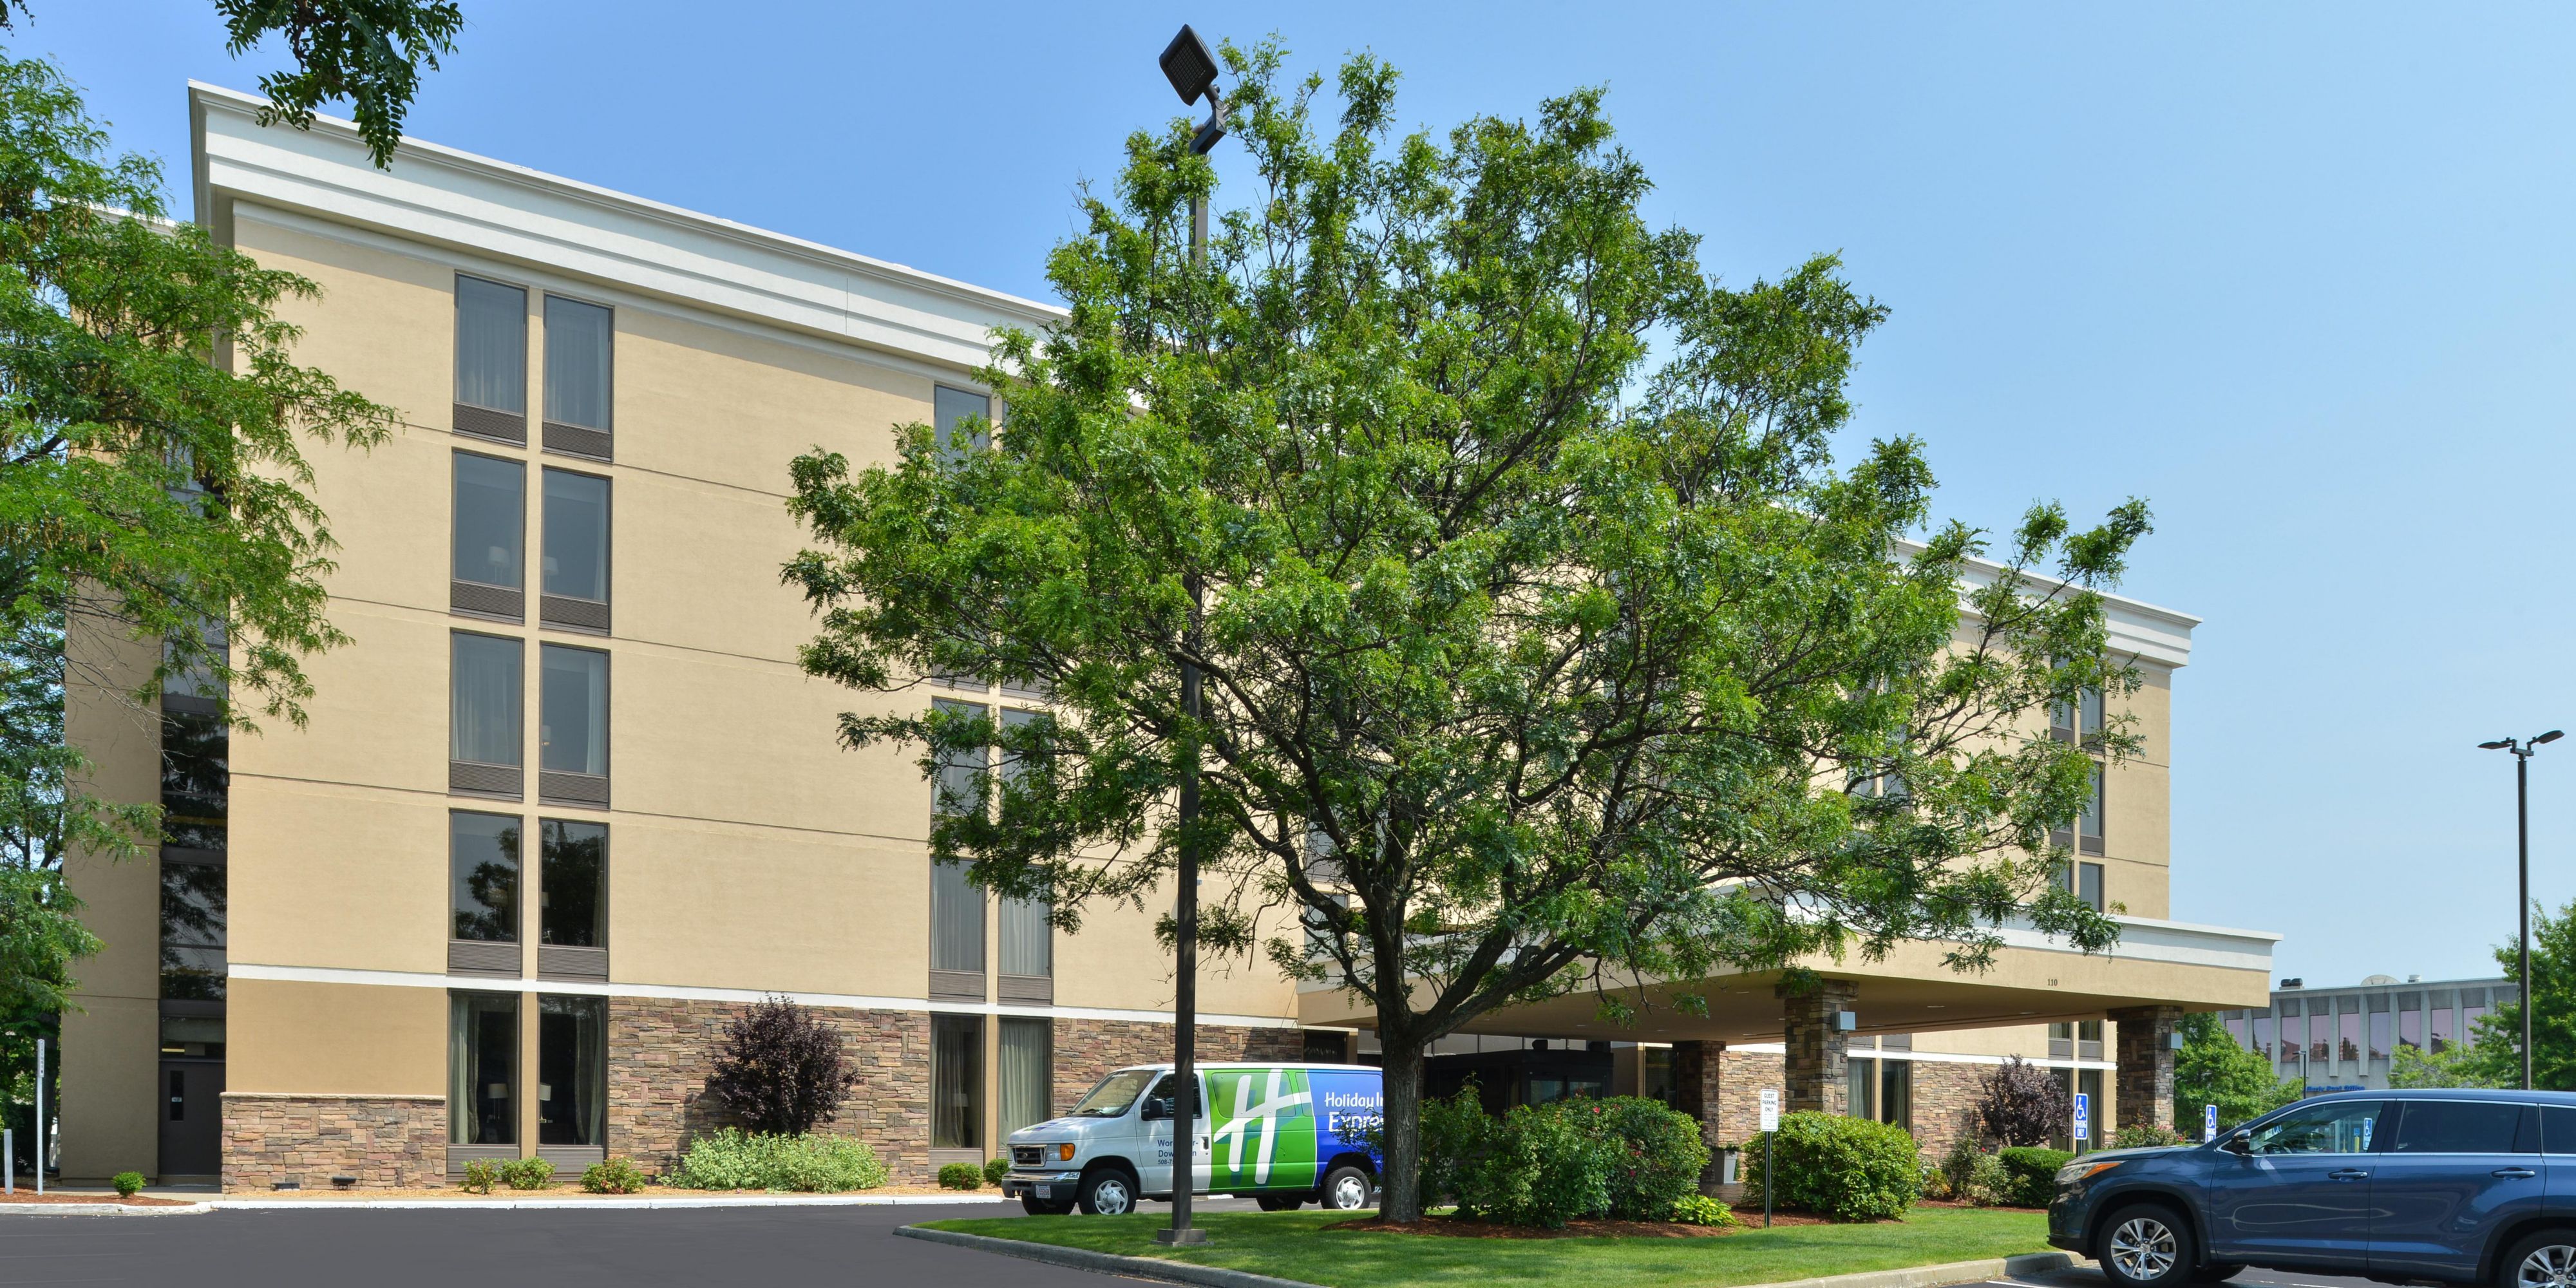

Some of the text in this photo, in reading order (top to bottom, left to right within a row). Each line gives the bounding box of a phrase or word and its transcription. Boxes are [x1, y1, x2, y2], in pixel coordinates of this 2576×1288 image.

[2047, 978, 2058, 987] 110
[1324, 1092, 1374, 1109] Holiday
[2077, 1128, 2085, 1137] ONLY
